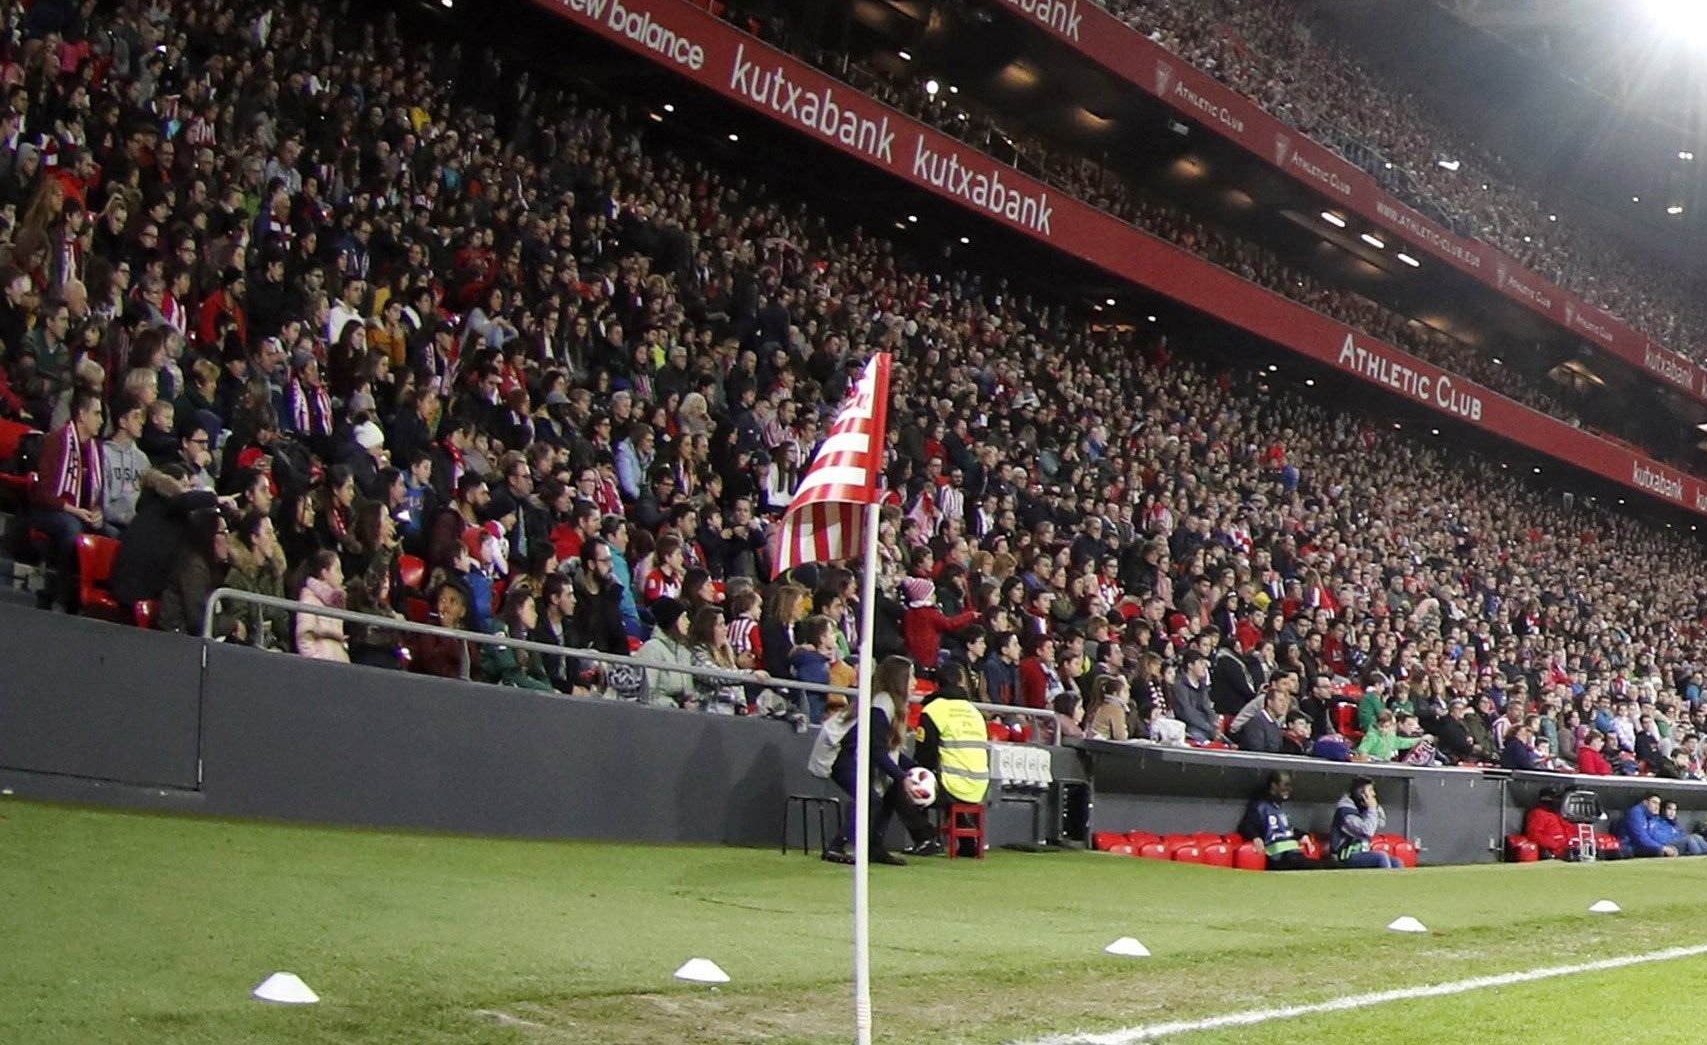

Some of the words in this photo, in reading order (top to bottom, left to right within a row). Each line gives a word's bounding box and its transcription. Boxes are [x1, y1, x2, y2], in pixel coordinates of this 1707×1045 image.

[730, 43, 895, 164] kutxabank
[913, 134, 1053, 235] kutxabank
[1339, 333, 1430, 400] ATHLETIC
[1436, 375, 1482, 421] CLUB
[1644, 343, 1693, 390] kutxabank
[1632, 460, 1684, 501] kutxabank
